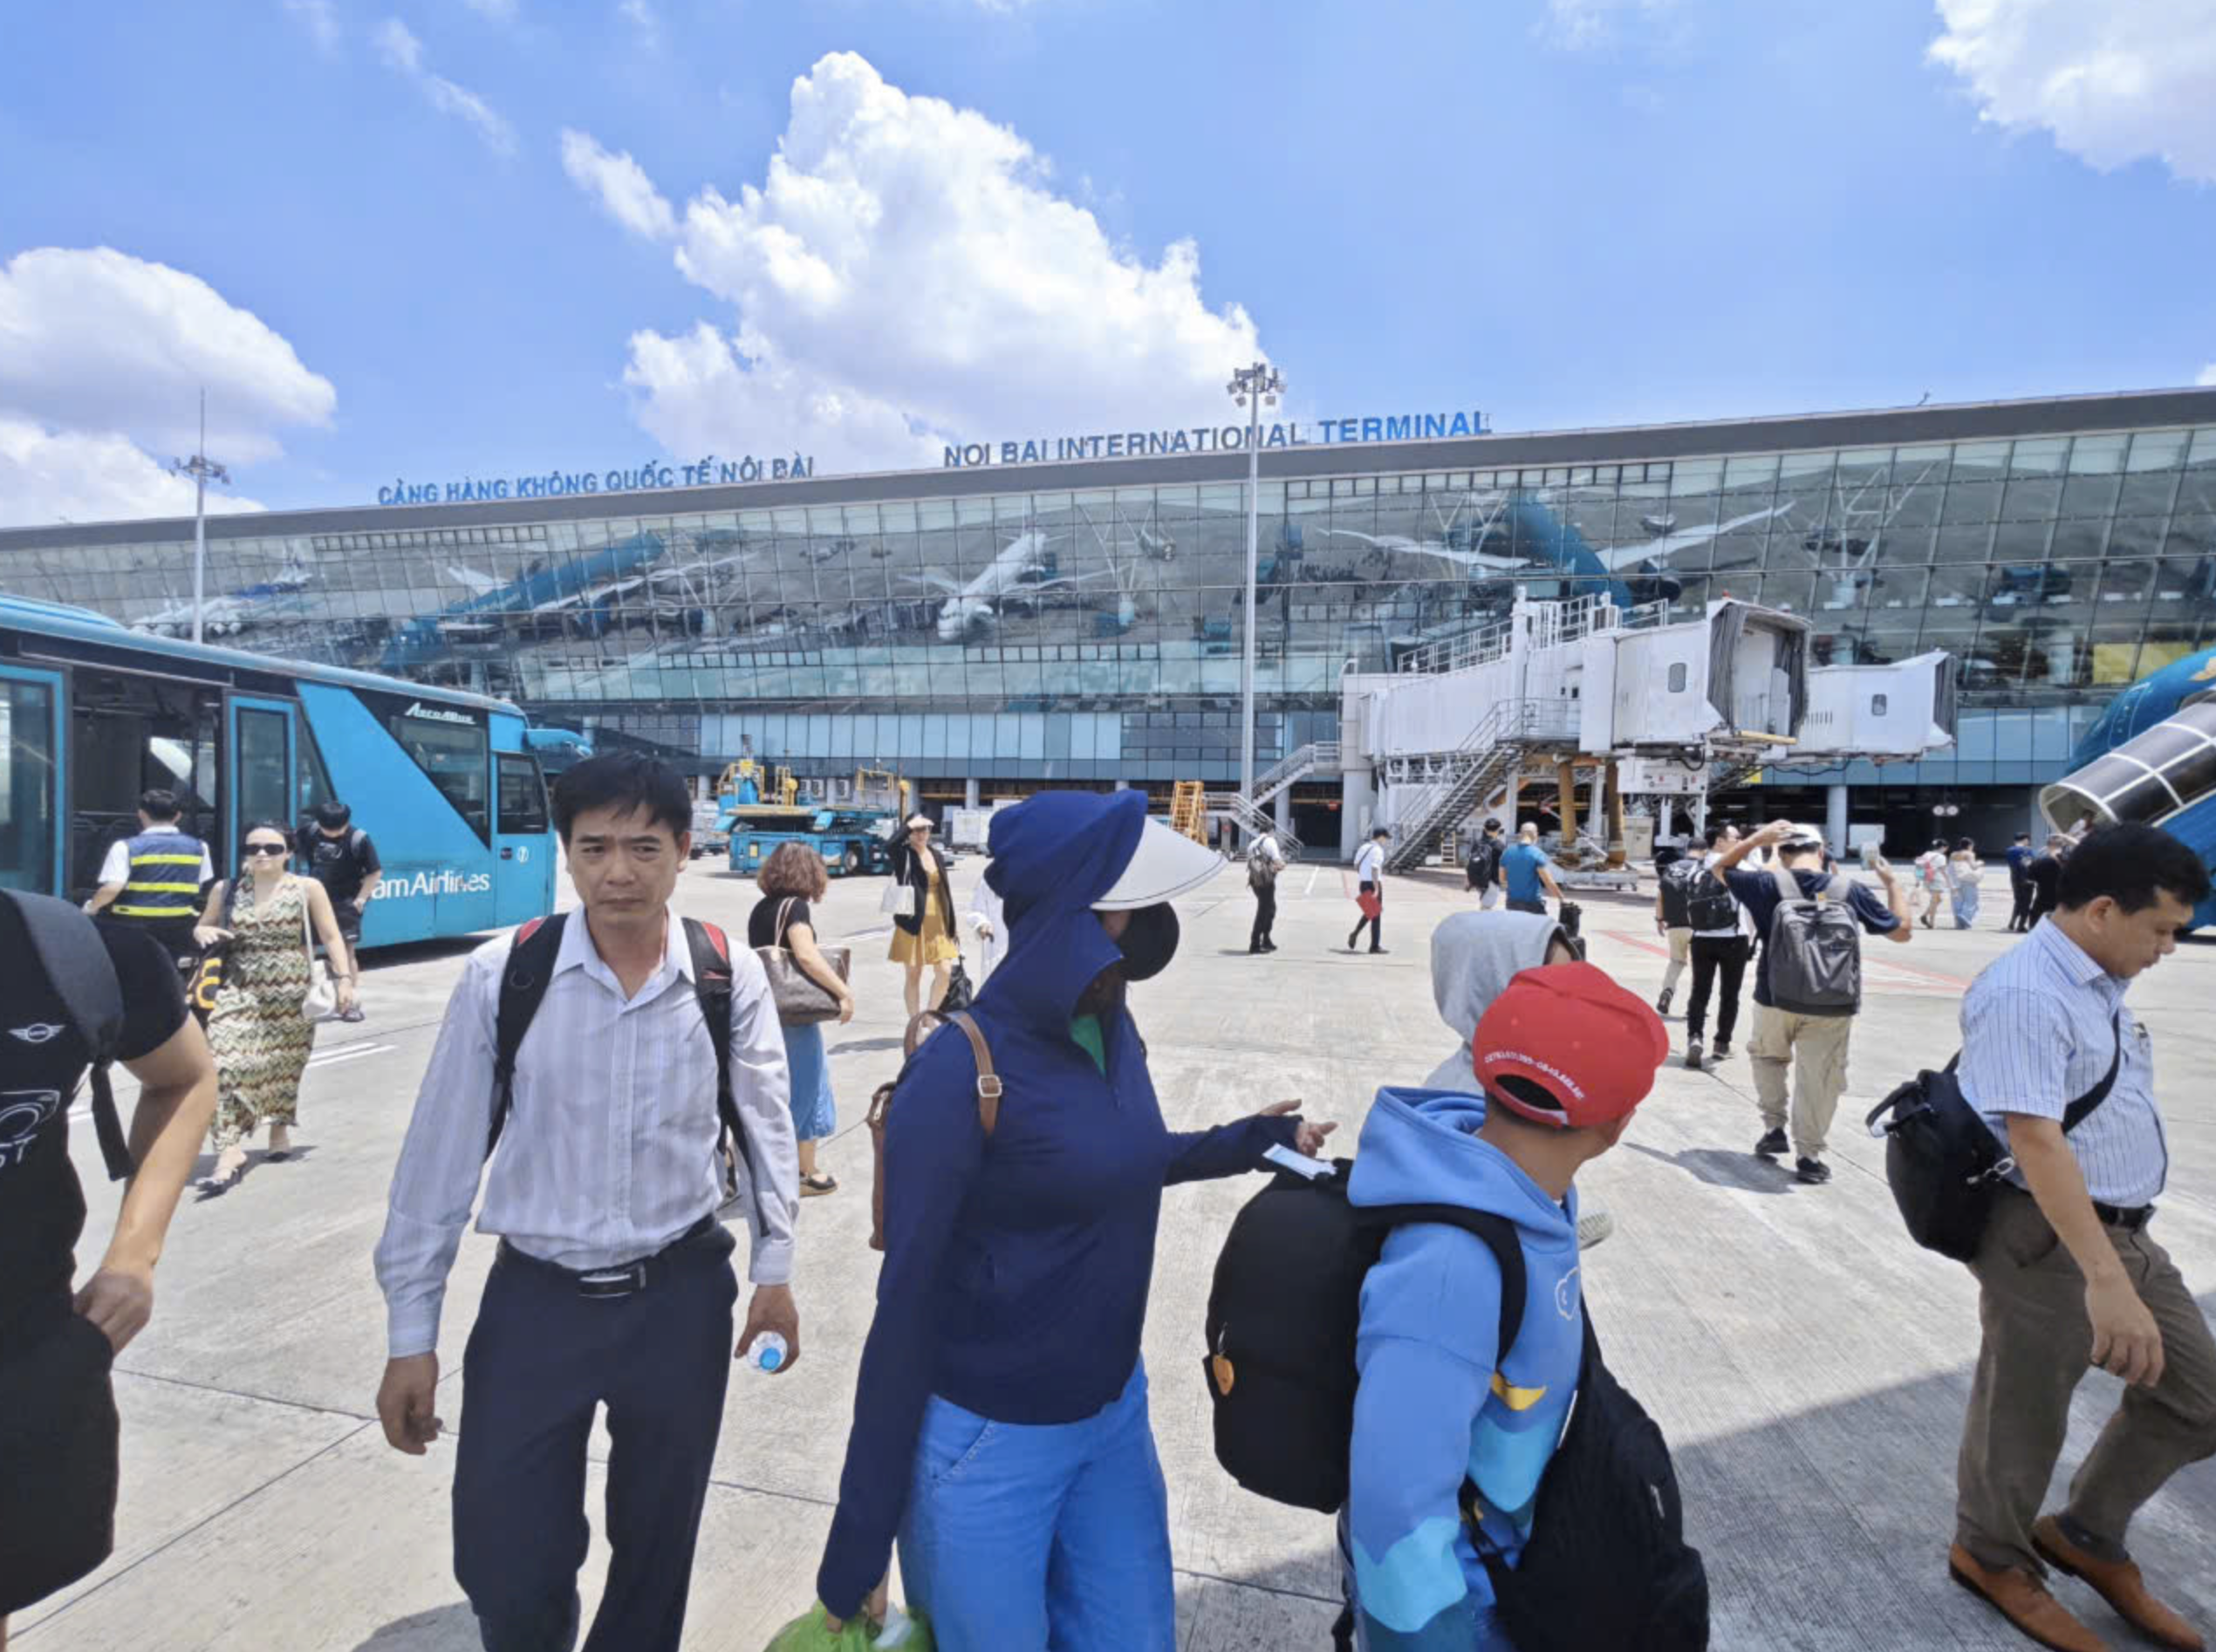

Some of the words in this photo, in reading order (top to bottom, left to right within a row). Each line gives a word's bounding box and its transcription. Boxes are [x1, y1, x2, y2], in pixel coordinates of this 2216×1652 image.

[944, 443, 990, 468] NOI
[1001, 440, 1047, 463] BAI
[1058, 422, 1307, 461] INTERNATIONAL
[1318, 411, 1492, 444] TERMINAL
[446, 476, 508, 502] HÀNG
[517, 470, 598, 497] KHÔNG
[605, 460, 674, 491] QUỐC
[681, 455, 714, 485] TẾ
[772, 451, 814, 480] BÀI
[410, 870, 491, 898] Airlines
